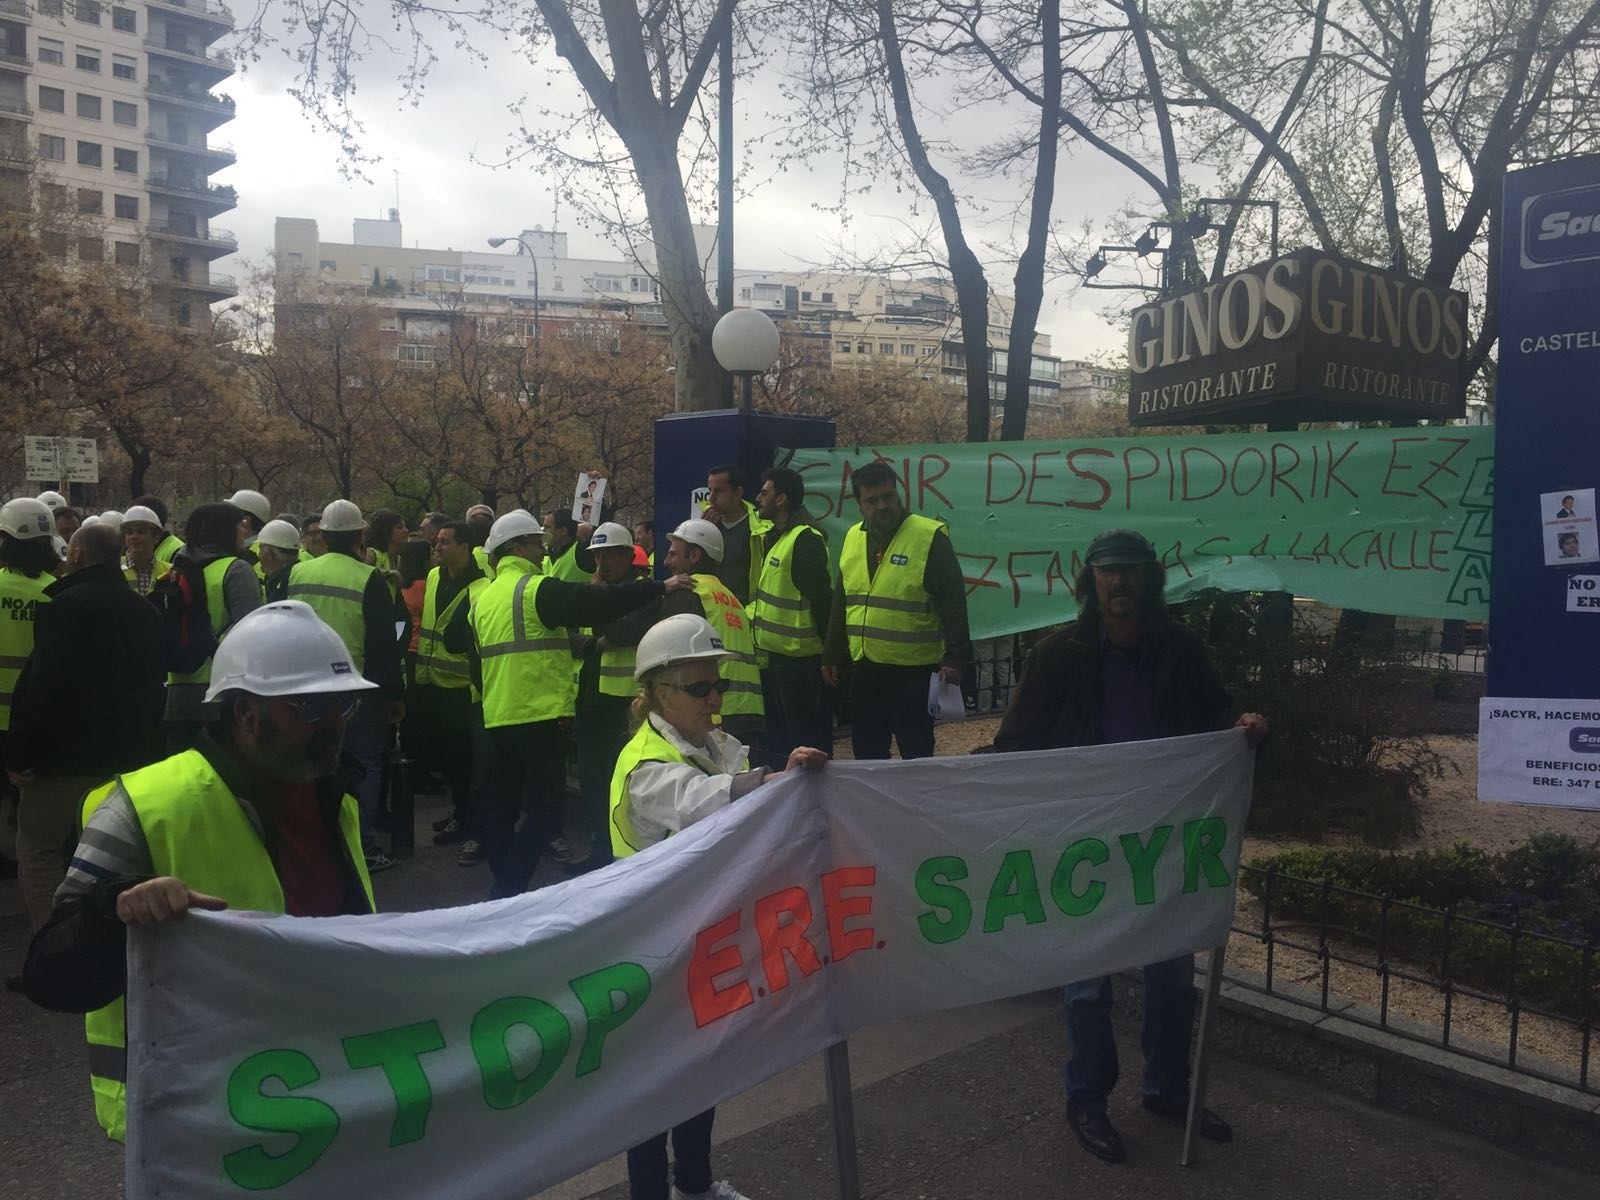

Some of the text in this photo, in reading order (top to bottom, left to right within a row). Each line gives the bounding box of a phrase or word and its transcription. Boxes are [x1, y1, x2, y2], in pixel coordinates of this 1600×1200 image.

[1128, 258, 1301, 374] GINOS
[1310, 258, 1464, 360] GINOS
[1520, 331, 1600, 353] CASTEL
[1138, 362, 1277, 415] RISTORANTE
[1323, 360, 1451, 406] RISTORANTE
[985, 441, 1359, 511] DESPIDORIK
[1382, 437, 1470, 508] EZ
[1569, 579, 1596, 590] NO
[1490, 710, 1540, 720] ¡SACYR,
[1526, 760, 1600, 772] BENEFICIO
[1533, 777, 1562, 787] ERE:
[1567, 779, 1590, 788] 347
[222, 816, 1231, 1191] STOP E.R.E. SACYR
